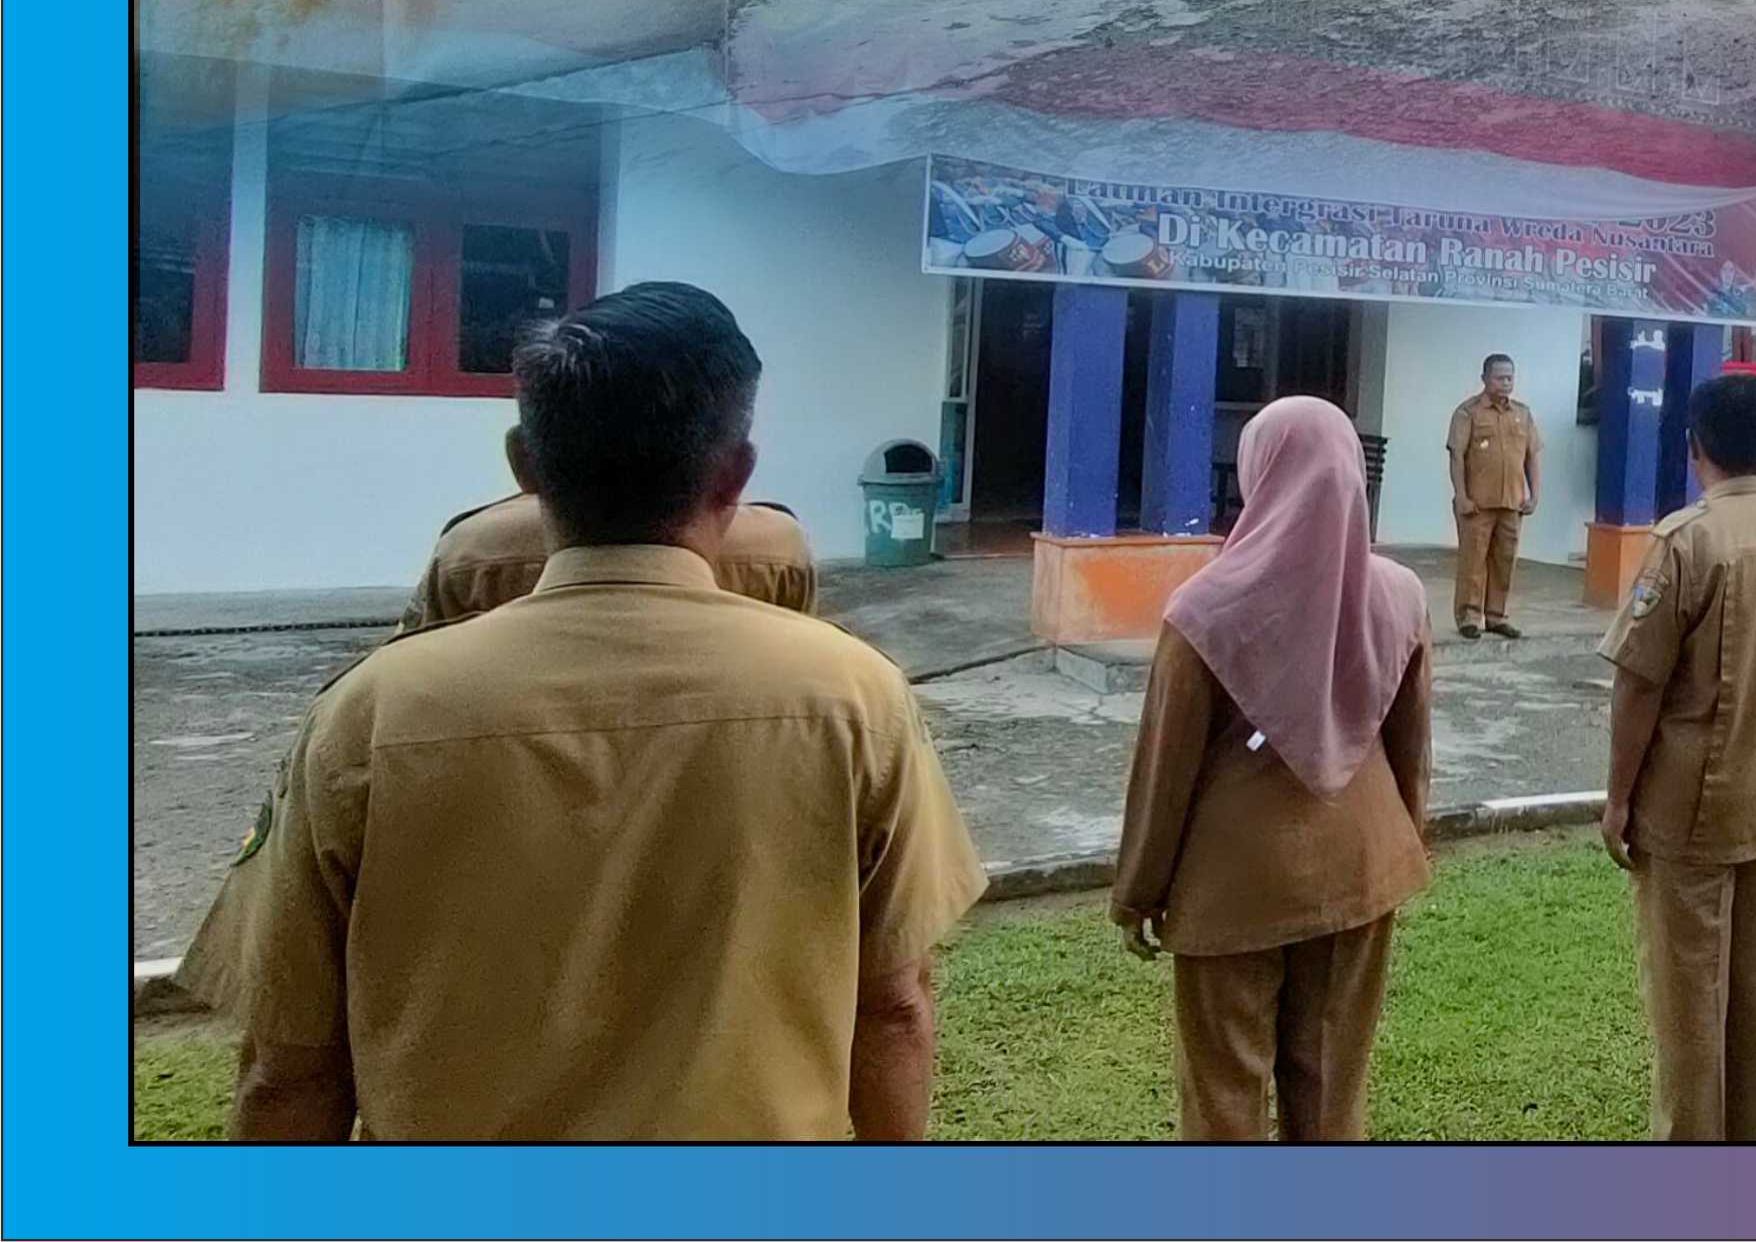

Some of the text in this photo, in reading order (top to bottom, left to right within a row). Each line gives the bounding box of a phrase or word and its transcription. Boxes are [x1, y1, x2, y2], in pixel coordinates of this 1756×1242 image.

[1158, 213, 1657, 283] Di Kecamatan Ranah Pesisir
[1593, 227, 1715, 257] Nusantara
[1169, 251, 1288, 274] Kabupaten
[1293, 258, 1364, 278] Pesisir
[1368, 262, 1440, 284] Selatan
[1445, 269, 1518, 289] Provinsi
[1523, 276, 1602, 297] Sumatera
[1606, 284, 1650, 299] Barat
